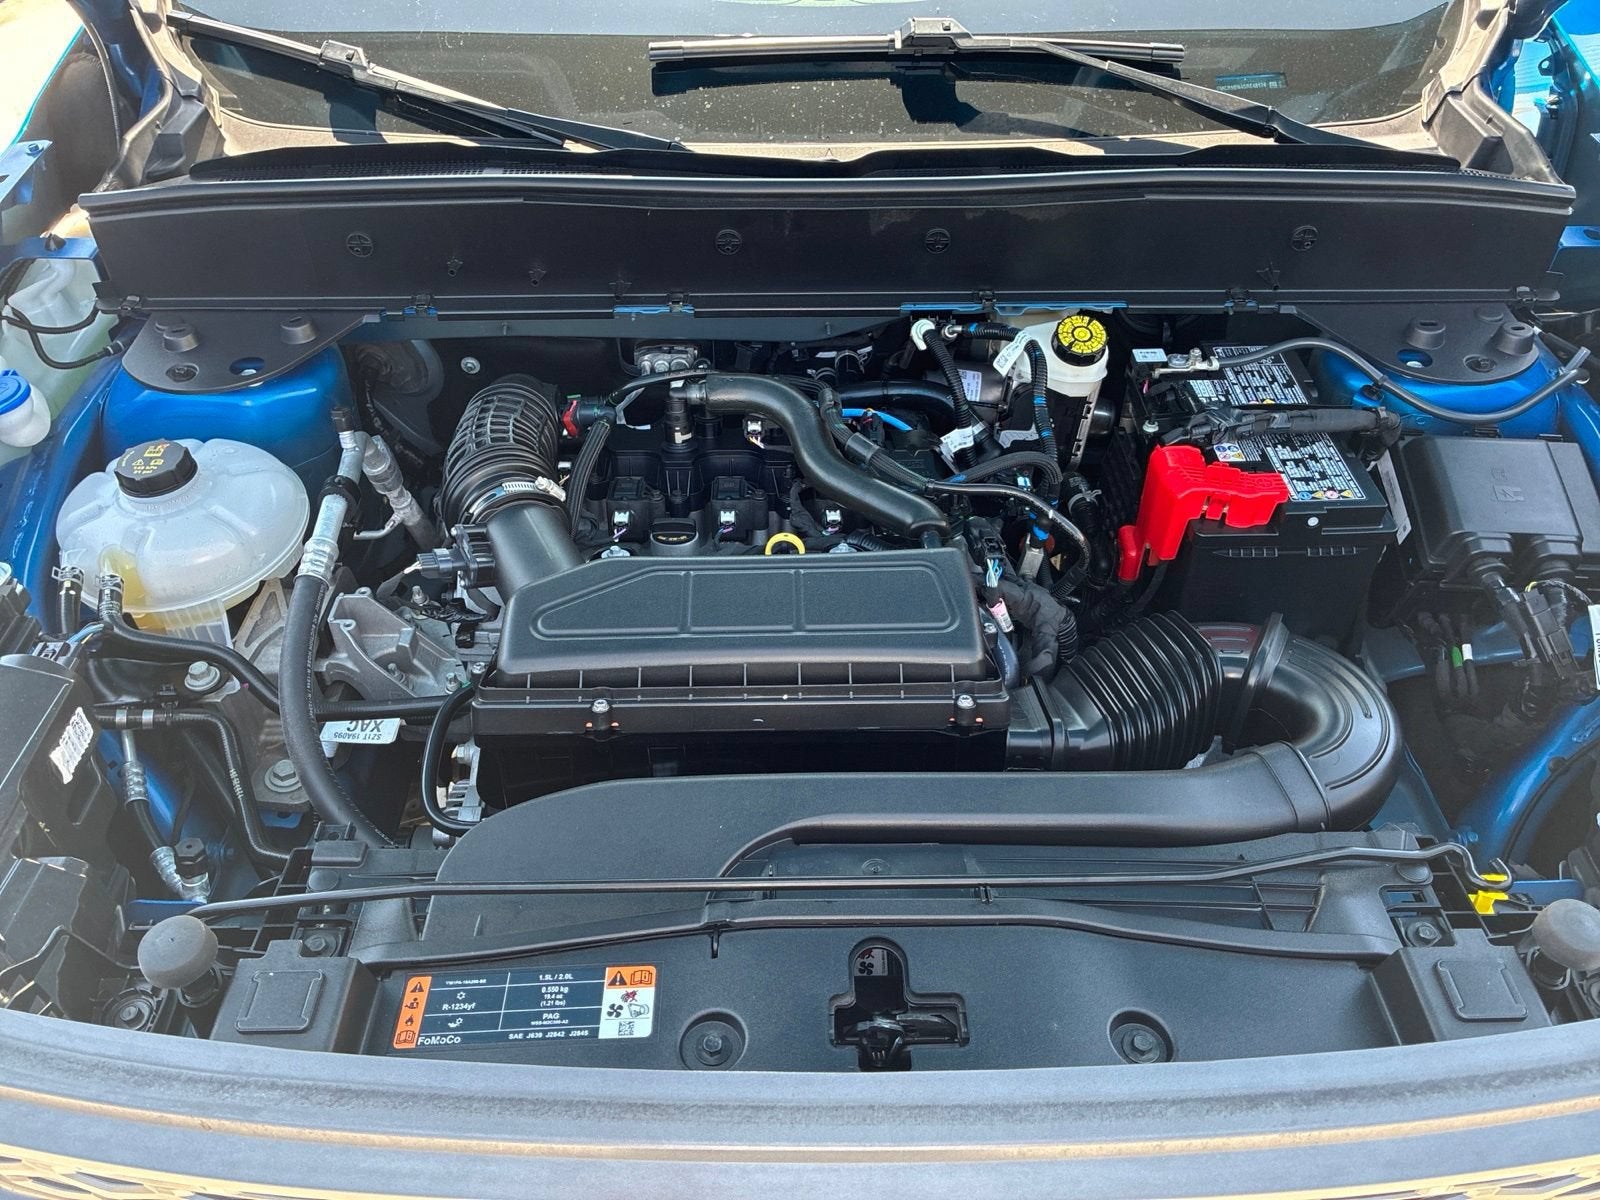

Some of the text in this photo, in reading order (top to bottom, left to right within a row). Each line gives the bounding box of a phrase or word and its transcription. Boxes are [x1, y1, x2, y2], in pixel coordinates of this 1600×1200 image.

[346, 720, 384, 733] XAC
[333, 731, 361, 740] 19A095
[541, 986, 569, 994] 0.550 kg
[442, 1002, 476, 1011] R-1234yf
[542, 1012, 560, 1020] PAG
[417, 1035, 462, 1046] FoMoCo
[508, 1032, 524, 1040] SAE
